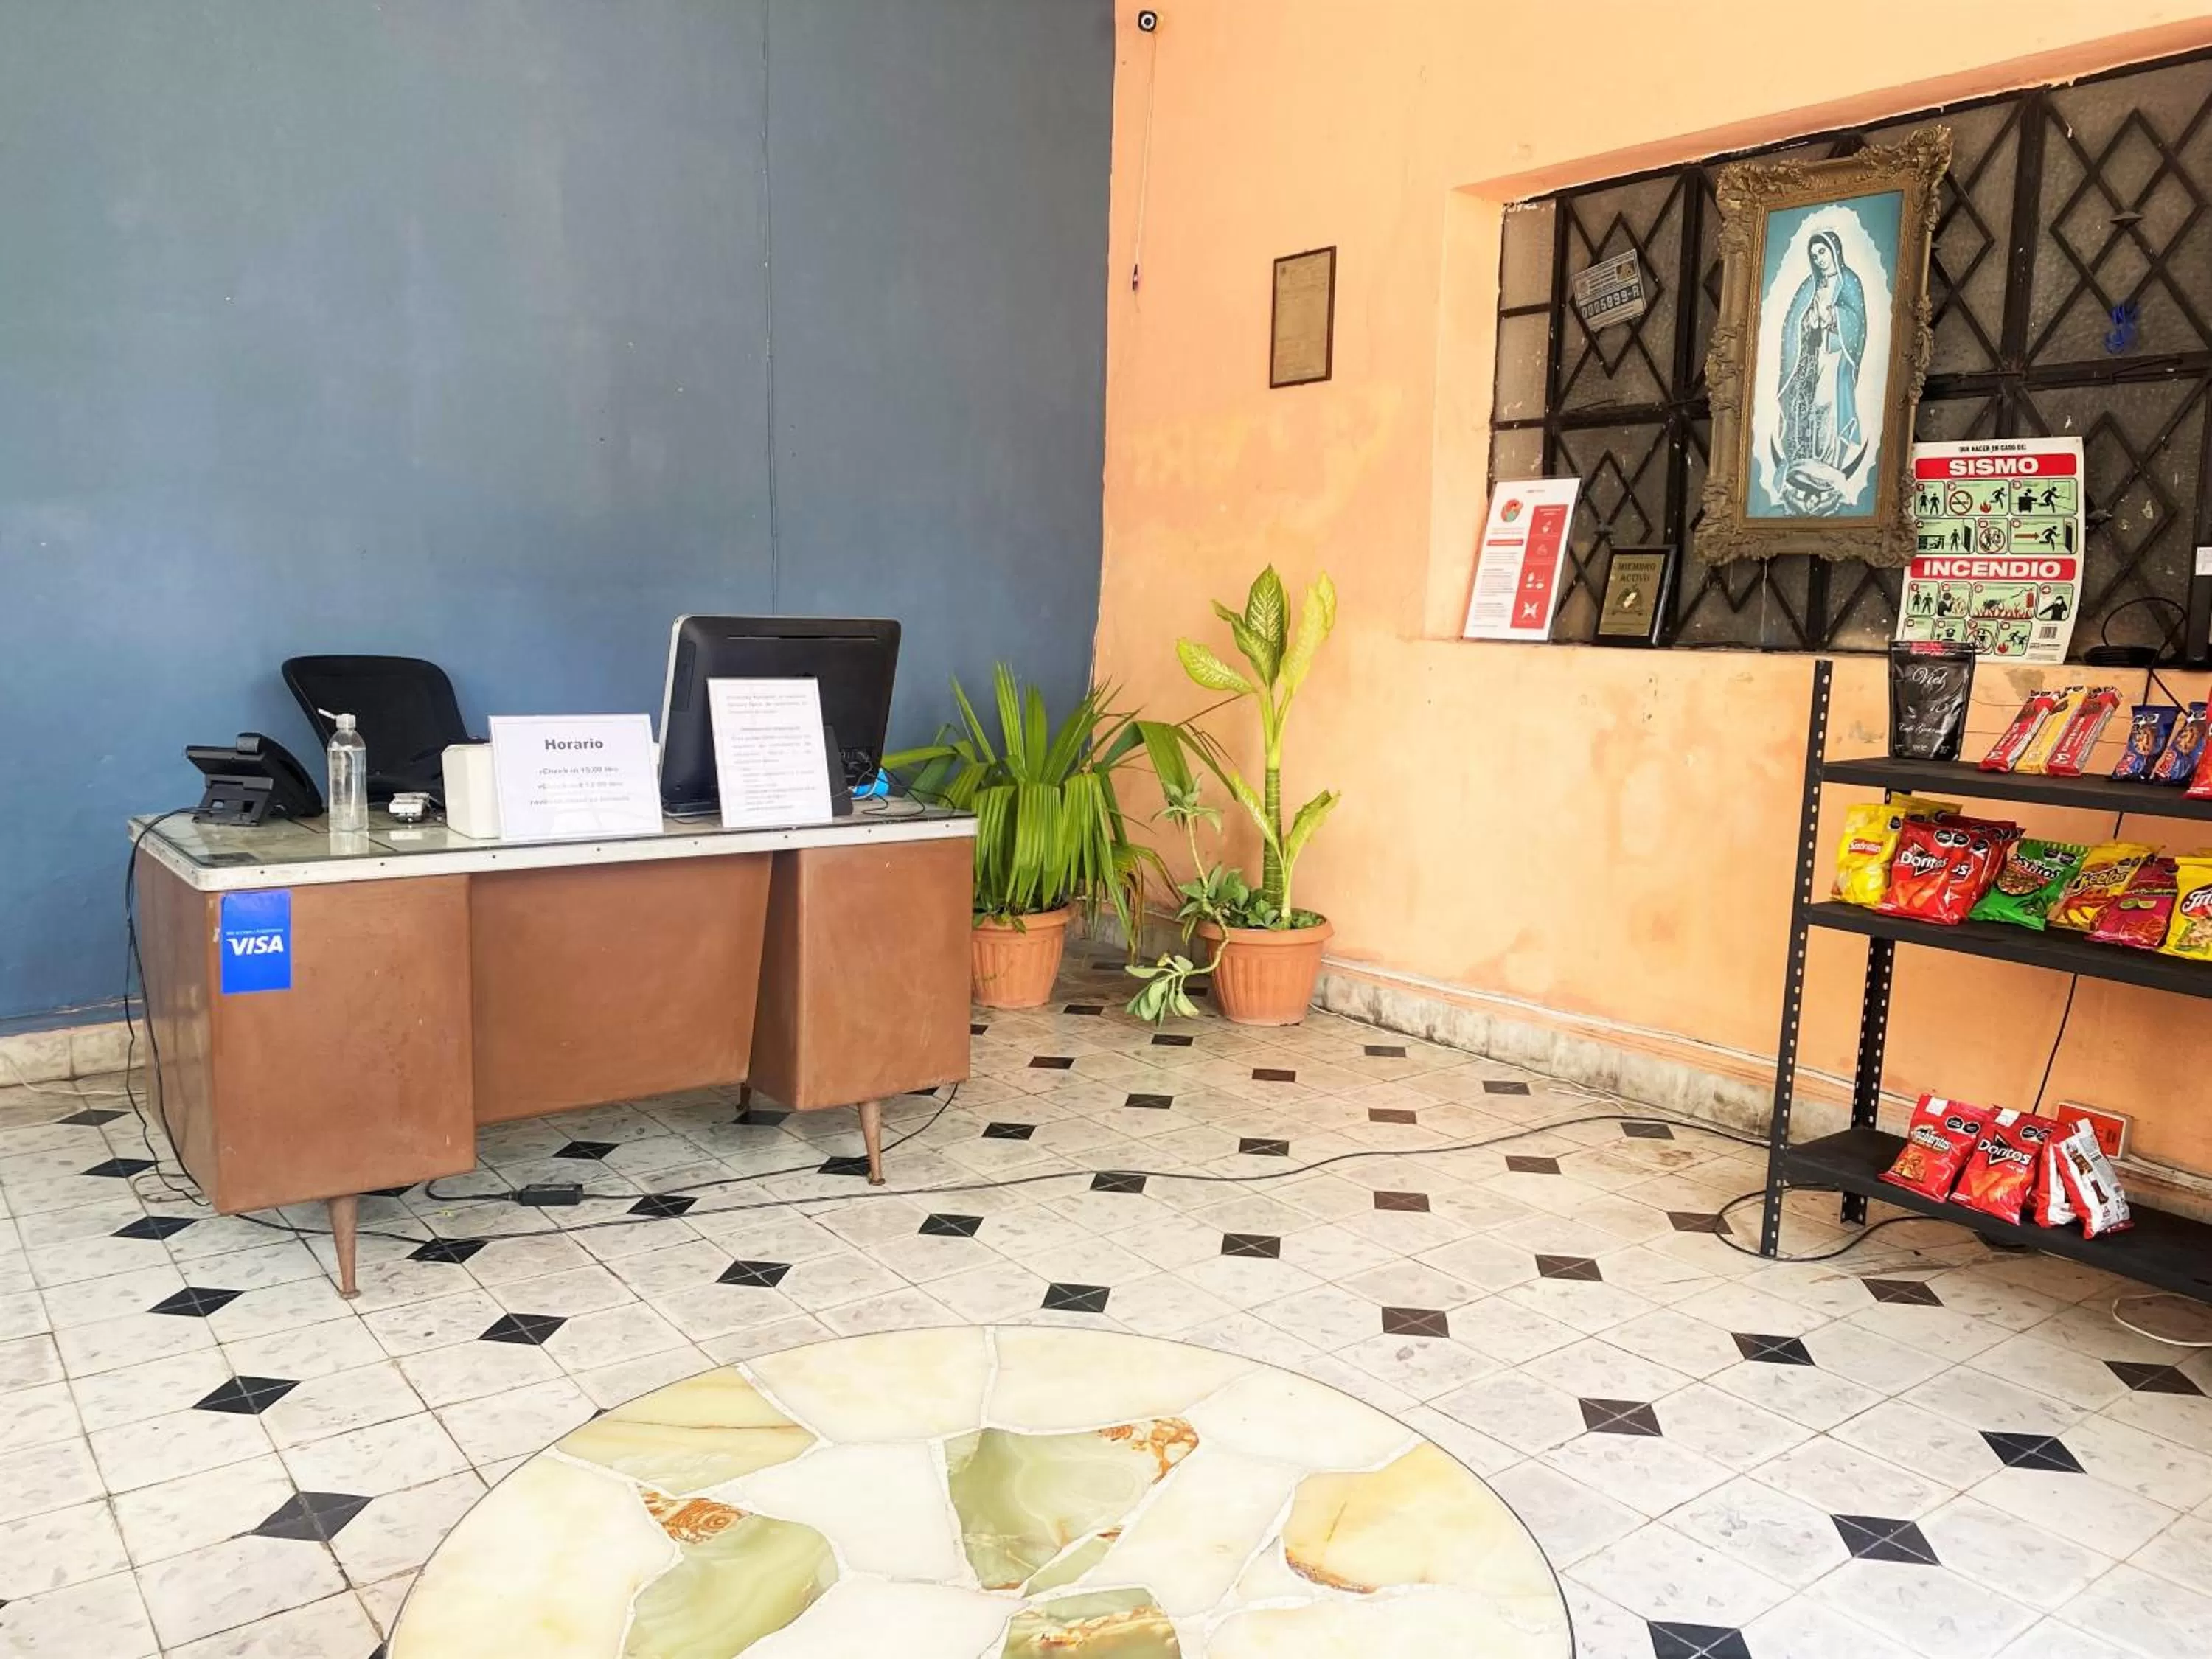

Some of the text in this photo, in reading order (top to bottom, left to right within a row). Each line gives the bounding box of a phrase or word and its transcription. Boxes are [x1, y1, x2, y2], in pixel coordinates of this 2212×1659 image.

[1949, 456, 2039, 476] SISMO
[1923, 560, 2061, 578] INCENDIO
[544, 738, 604, 751] Horario
[1899, 851, 1949, 868] Doritos
[226, 935, 284, 956] VISA
[1978, 1138, 2033, 1166] Doritos
